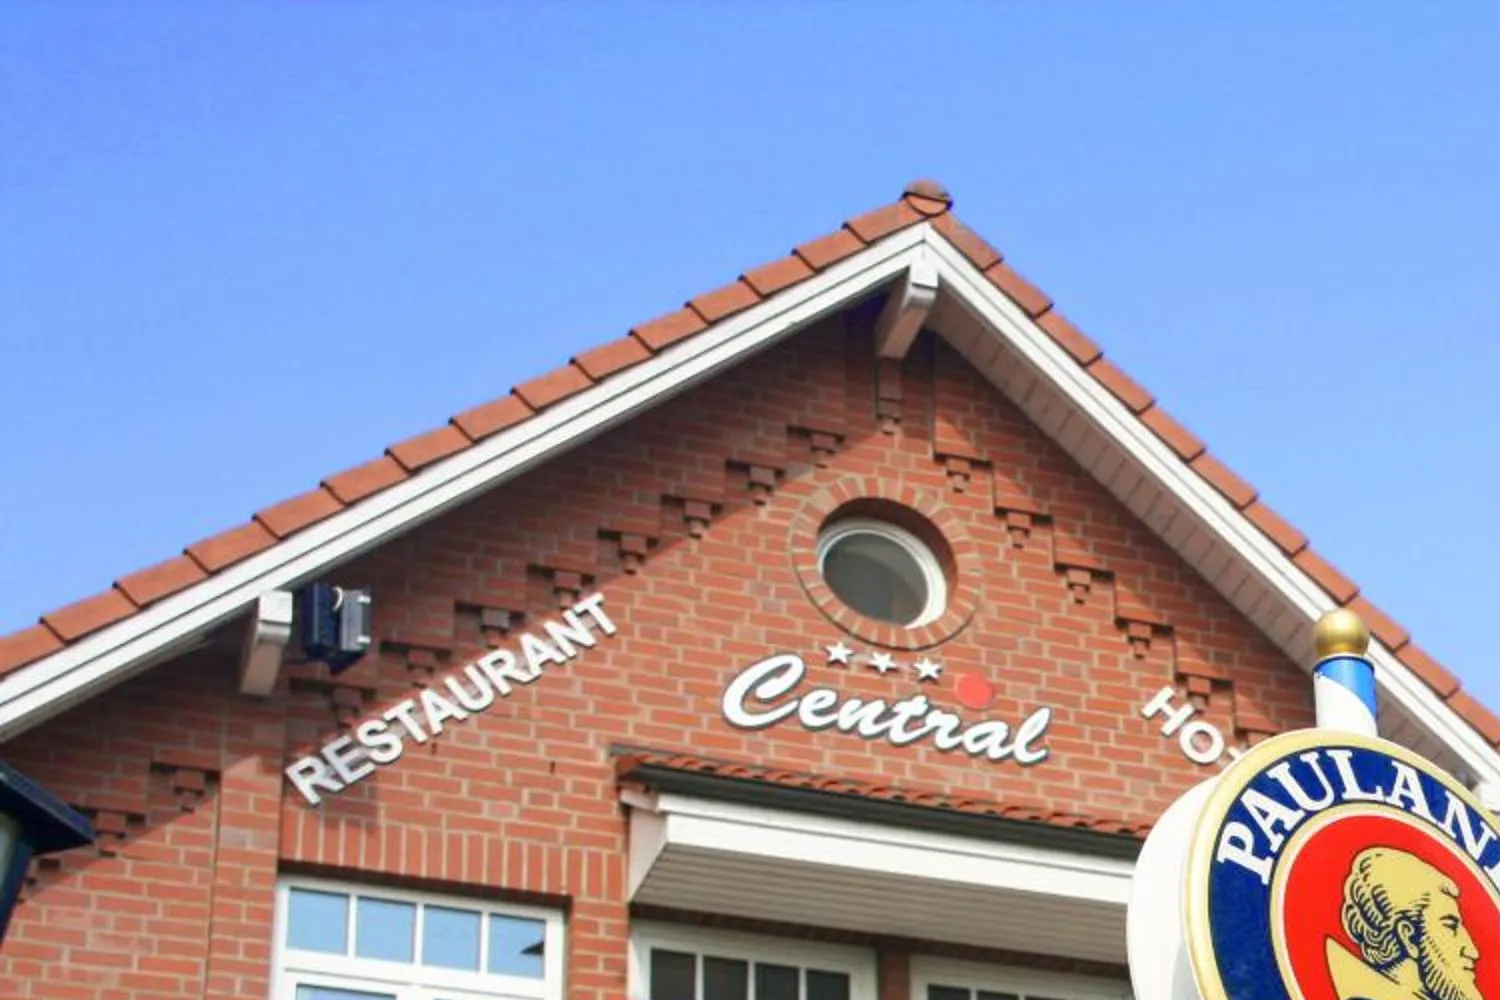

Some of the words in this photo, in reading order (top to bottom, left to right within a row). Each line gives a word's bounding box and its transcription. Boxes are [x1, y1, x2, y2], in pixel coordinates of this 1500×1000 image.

[285, 592, 617, 807] RESTAURANT
[722, 652, 1052, 766] Central
[1141, 685, 1243, 766] HO
